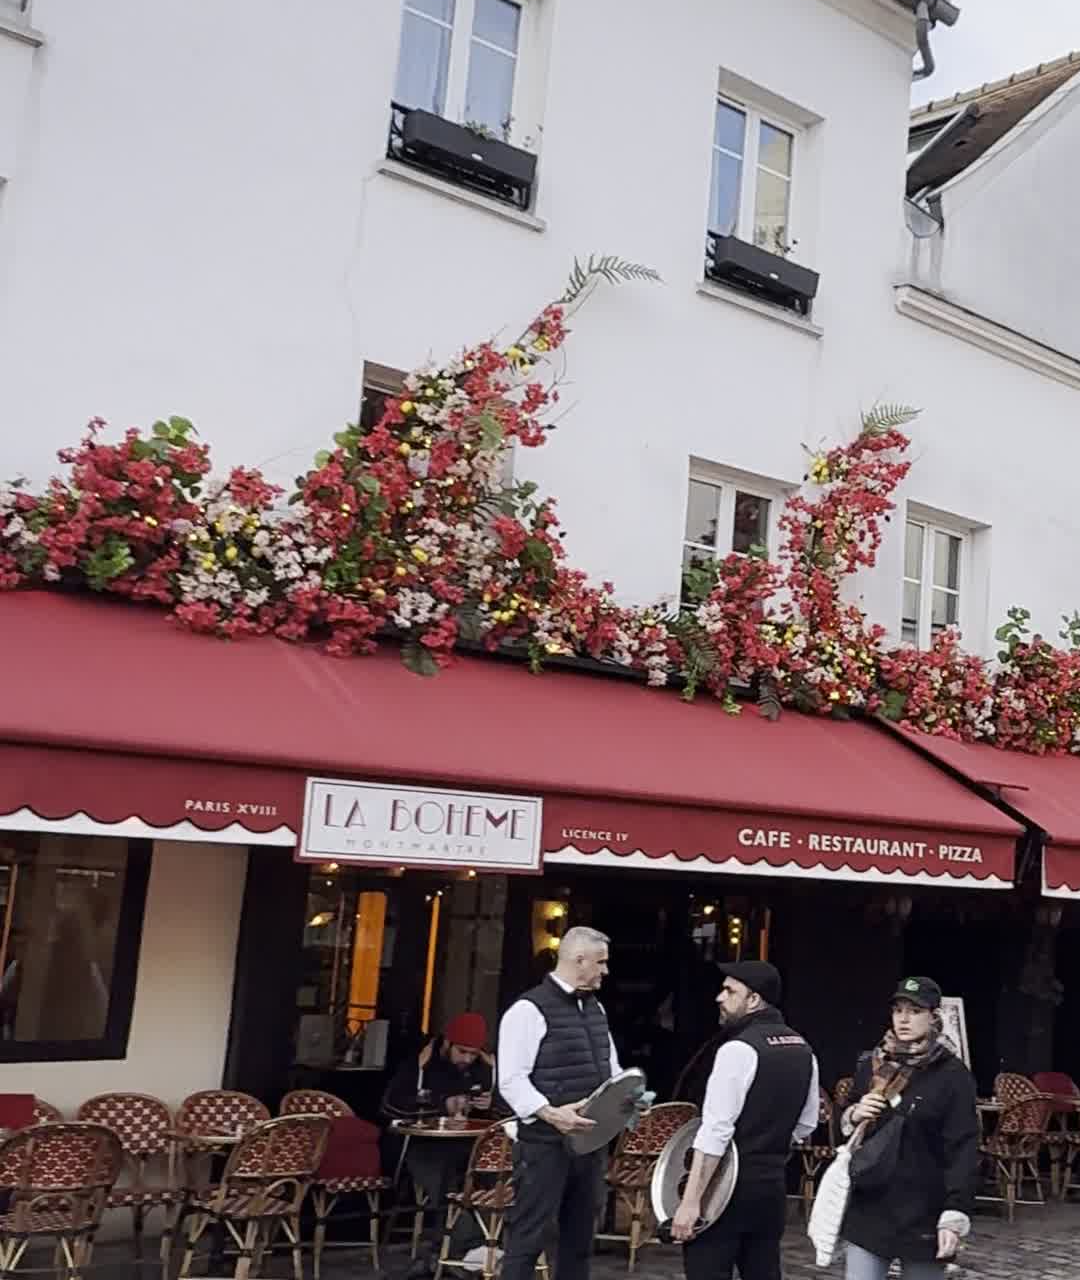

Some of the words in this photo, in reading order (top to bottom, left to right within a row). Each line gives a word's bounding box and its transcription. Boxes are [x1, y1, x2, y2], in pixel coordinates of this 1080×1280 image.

[184, 799, 231, 813] PARIS
[236, 803, 278, 816] XVIII
[323, 793, 367, 829] LA
[390, 799, 527, 841] BOHEME
[562, 828, 612, 841] LICENCE
[738, 828, 791, 848] CAFE
[808, 833, 927, 858] RESTAURANT
[938, 844, 983, 863] PIZZA
